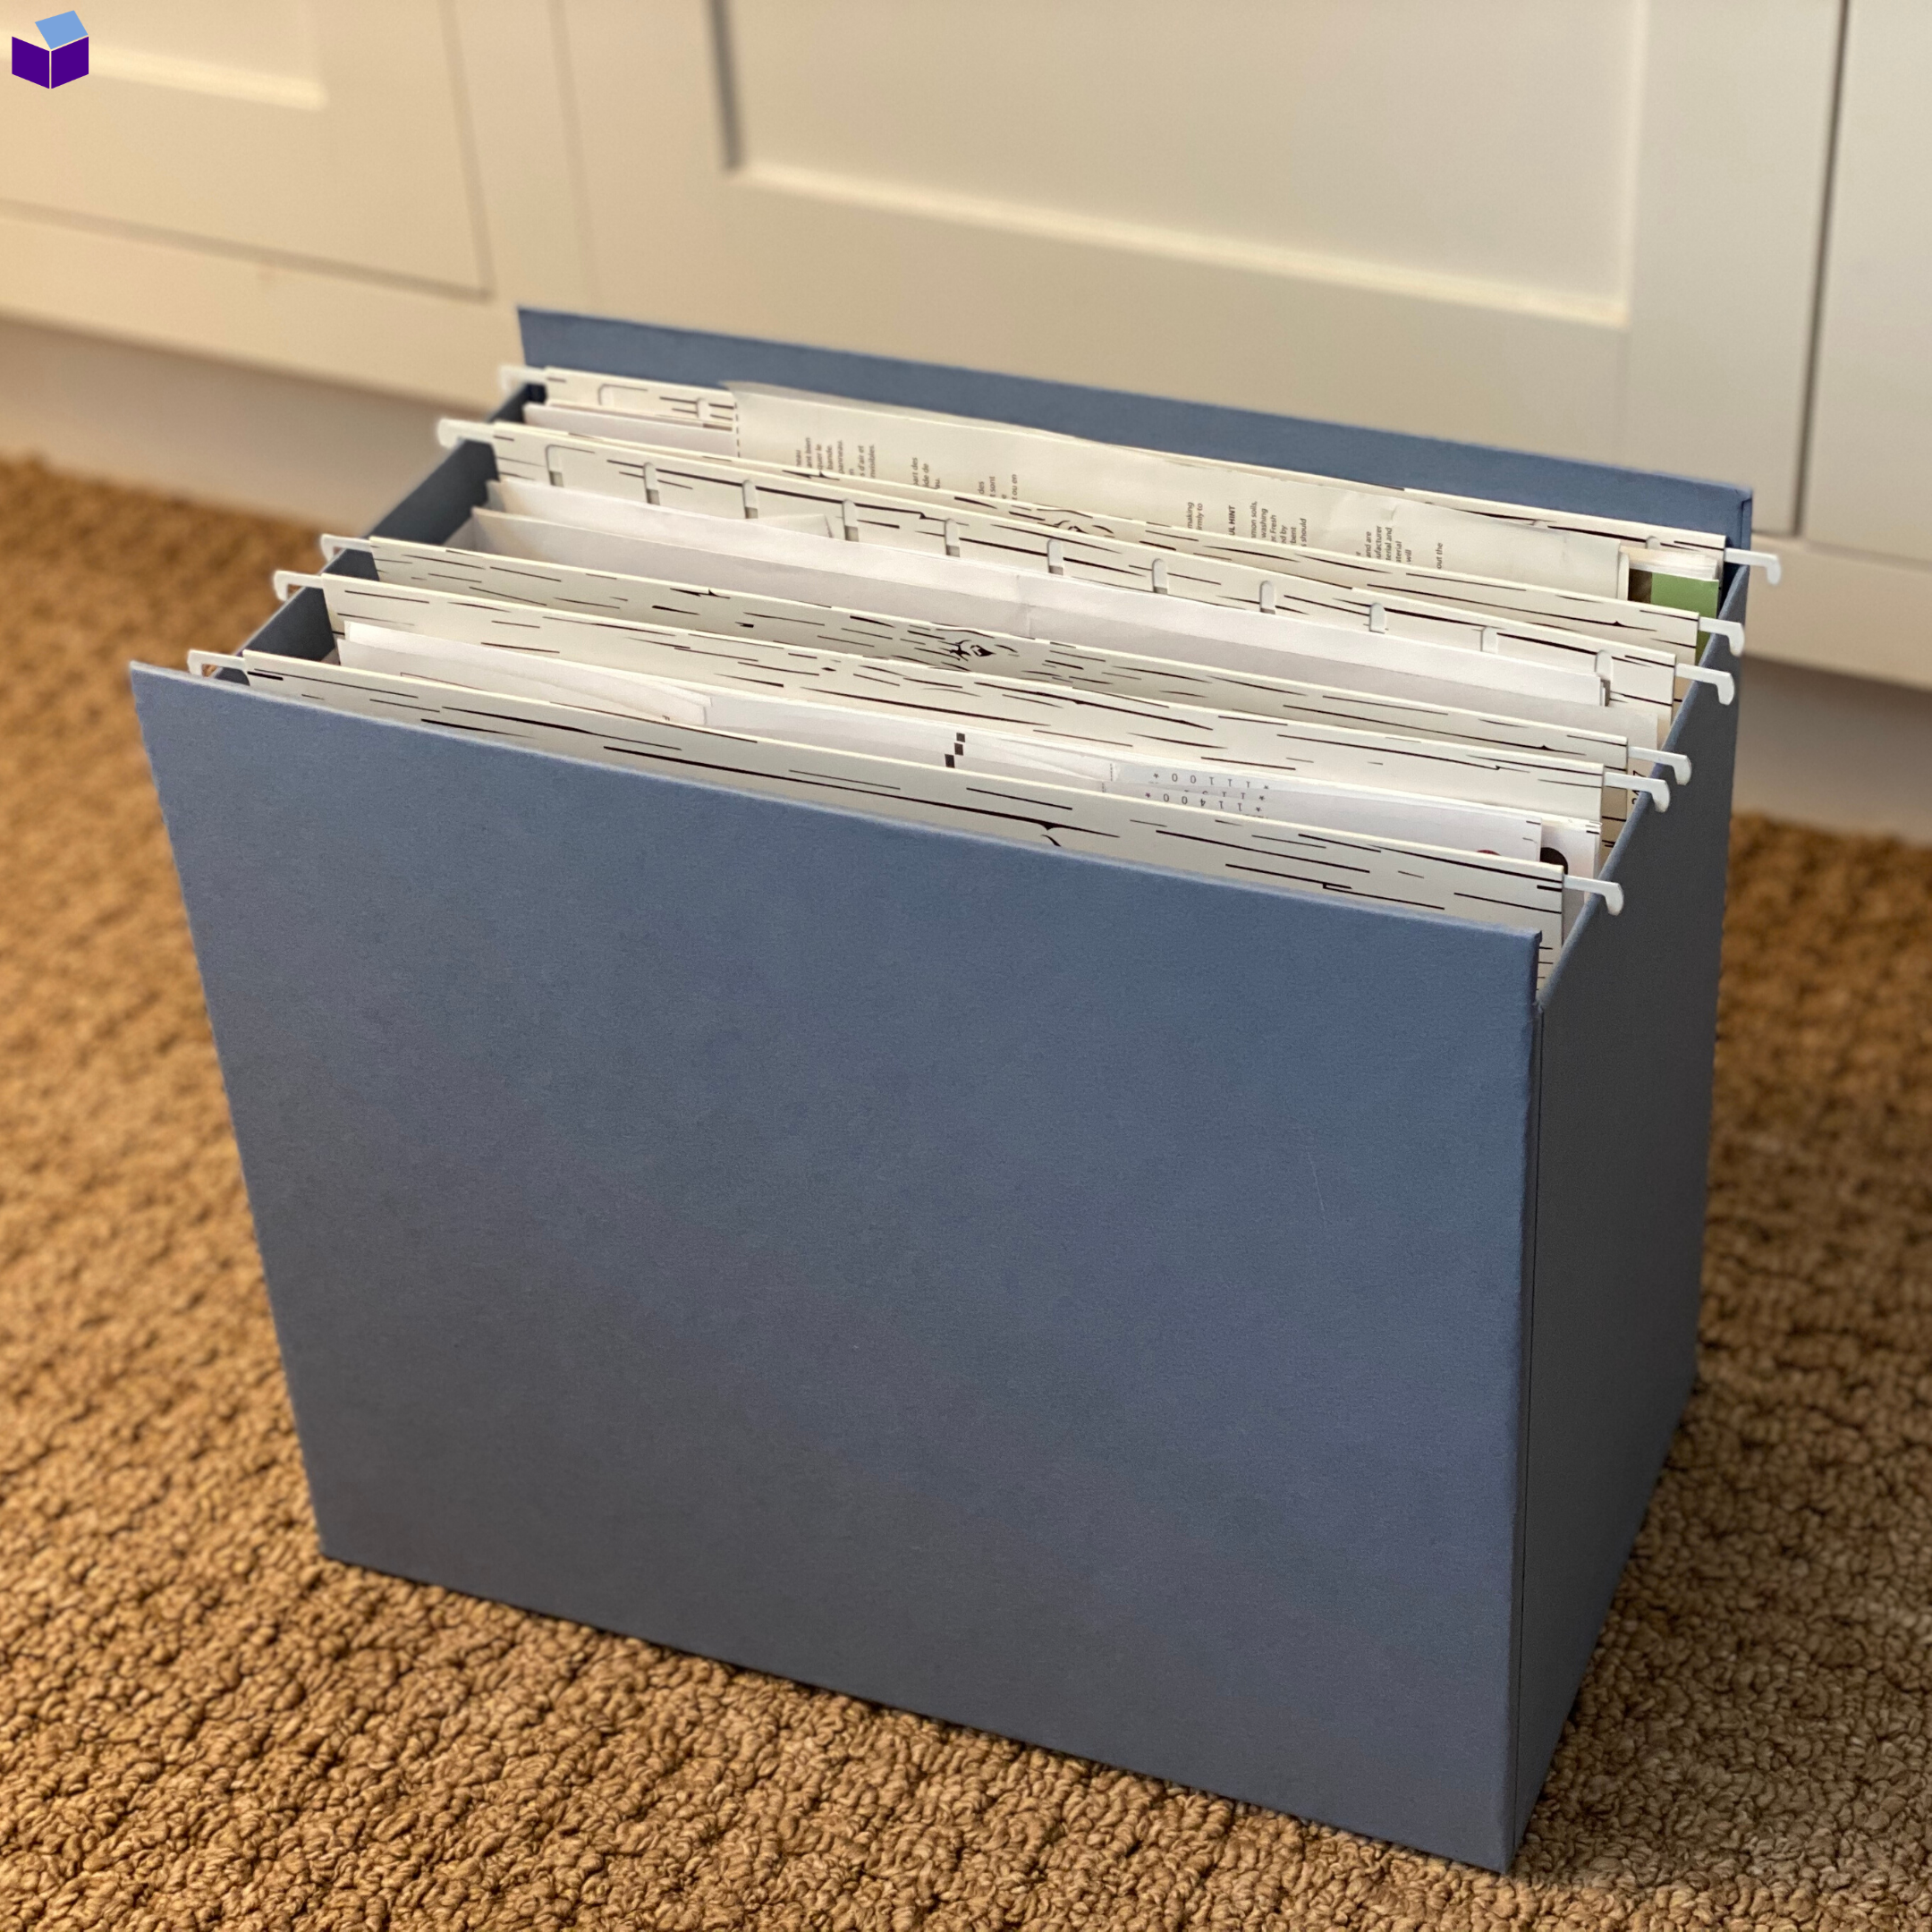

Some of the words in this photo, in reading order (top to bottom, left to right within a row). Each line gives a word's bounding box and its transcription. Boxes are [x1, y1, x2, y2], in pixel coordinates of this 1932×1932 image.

[922, 463, 929, 473] de
[1012, 474, 1018, 485] en
[1012, 486, 1018, 496] ou
[1196, 503, 1204, 512] to
[1250, 501, 1258, 519] soils,
[1186, 502, 1195, 530] making
[1260, 508, 1269, 538] washing
[1280, 525, 1289, 536] by
[1385, 527, 1394, 542] and
[1436, 542, 1444, 555] the
